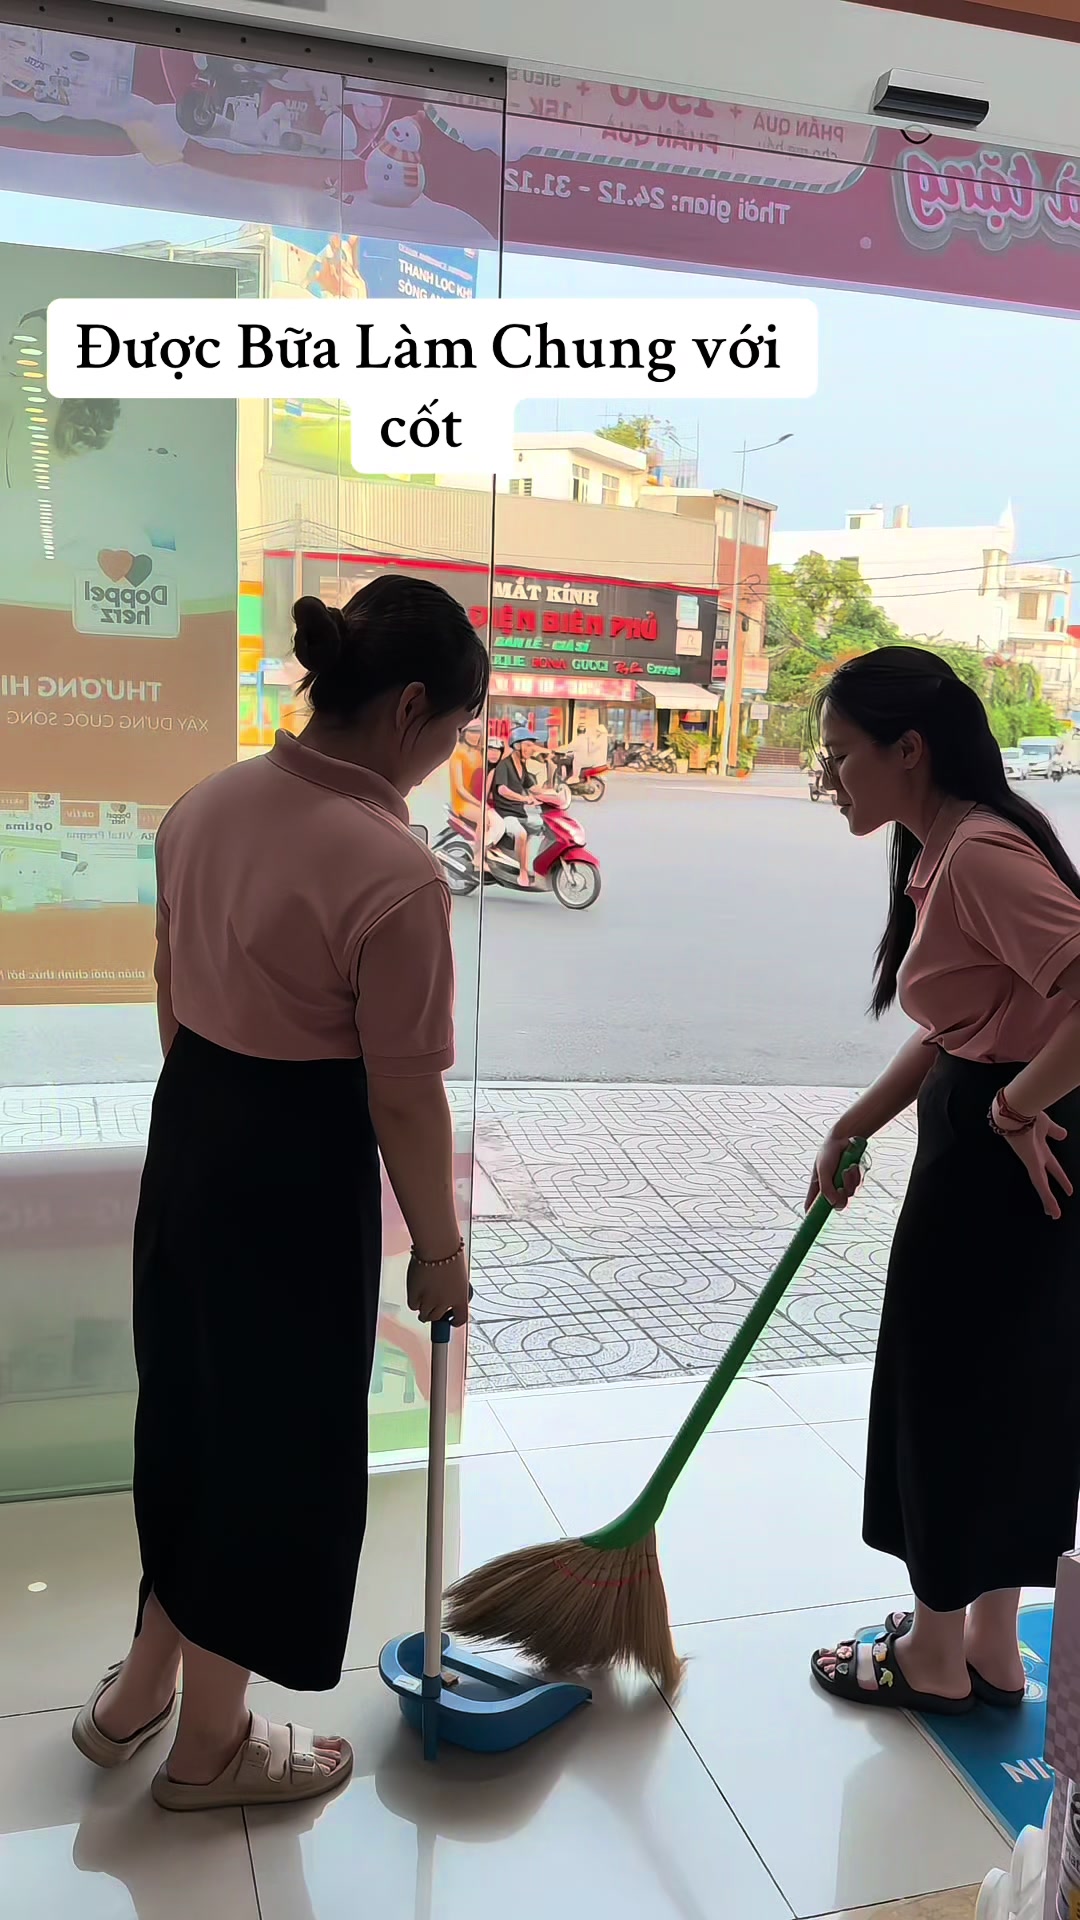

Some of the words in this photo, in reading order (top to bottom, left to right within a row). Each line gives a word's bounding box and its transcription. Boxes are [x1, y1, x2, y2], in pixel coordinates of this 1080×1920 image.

[398, 258, 434, 286] THANH
[493, 577, 541, 601] MẮT
[546, 583, 599, 606] KÍNH
[542, 608, 604, 637] BIÊN
[610, 611, 658, 641] PHỦ
[571, 659, 609, 672] GUCCI
